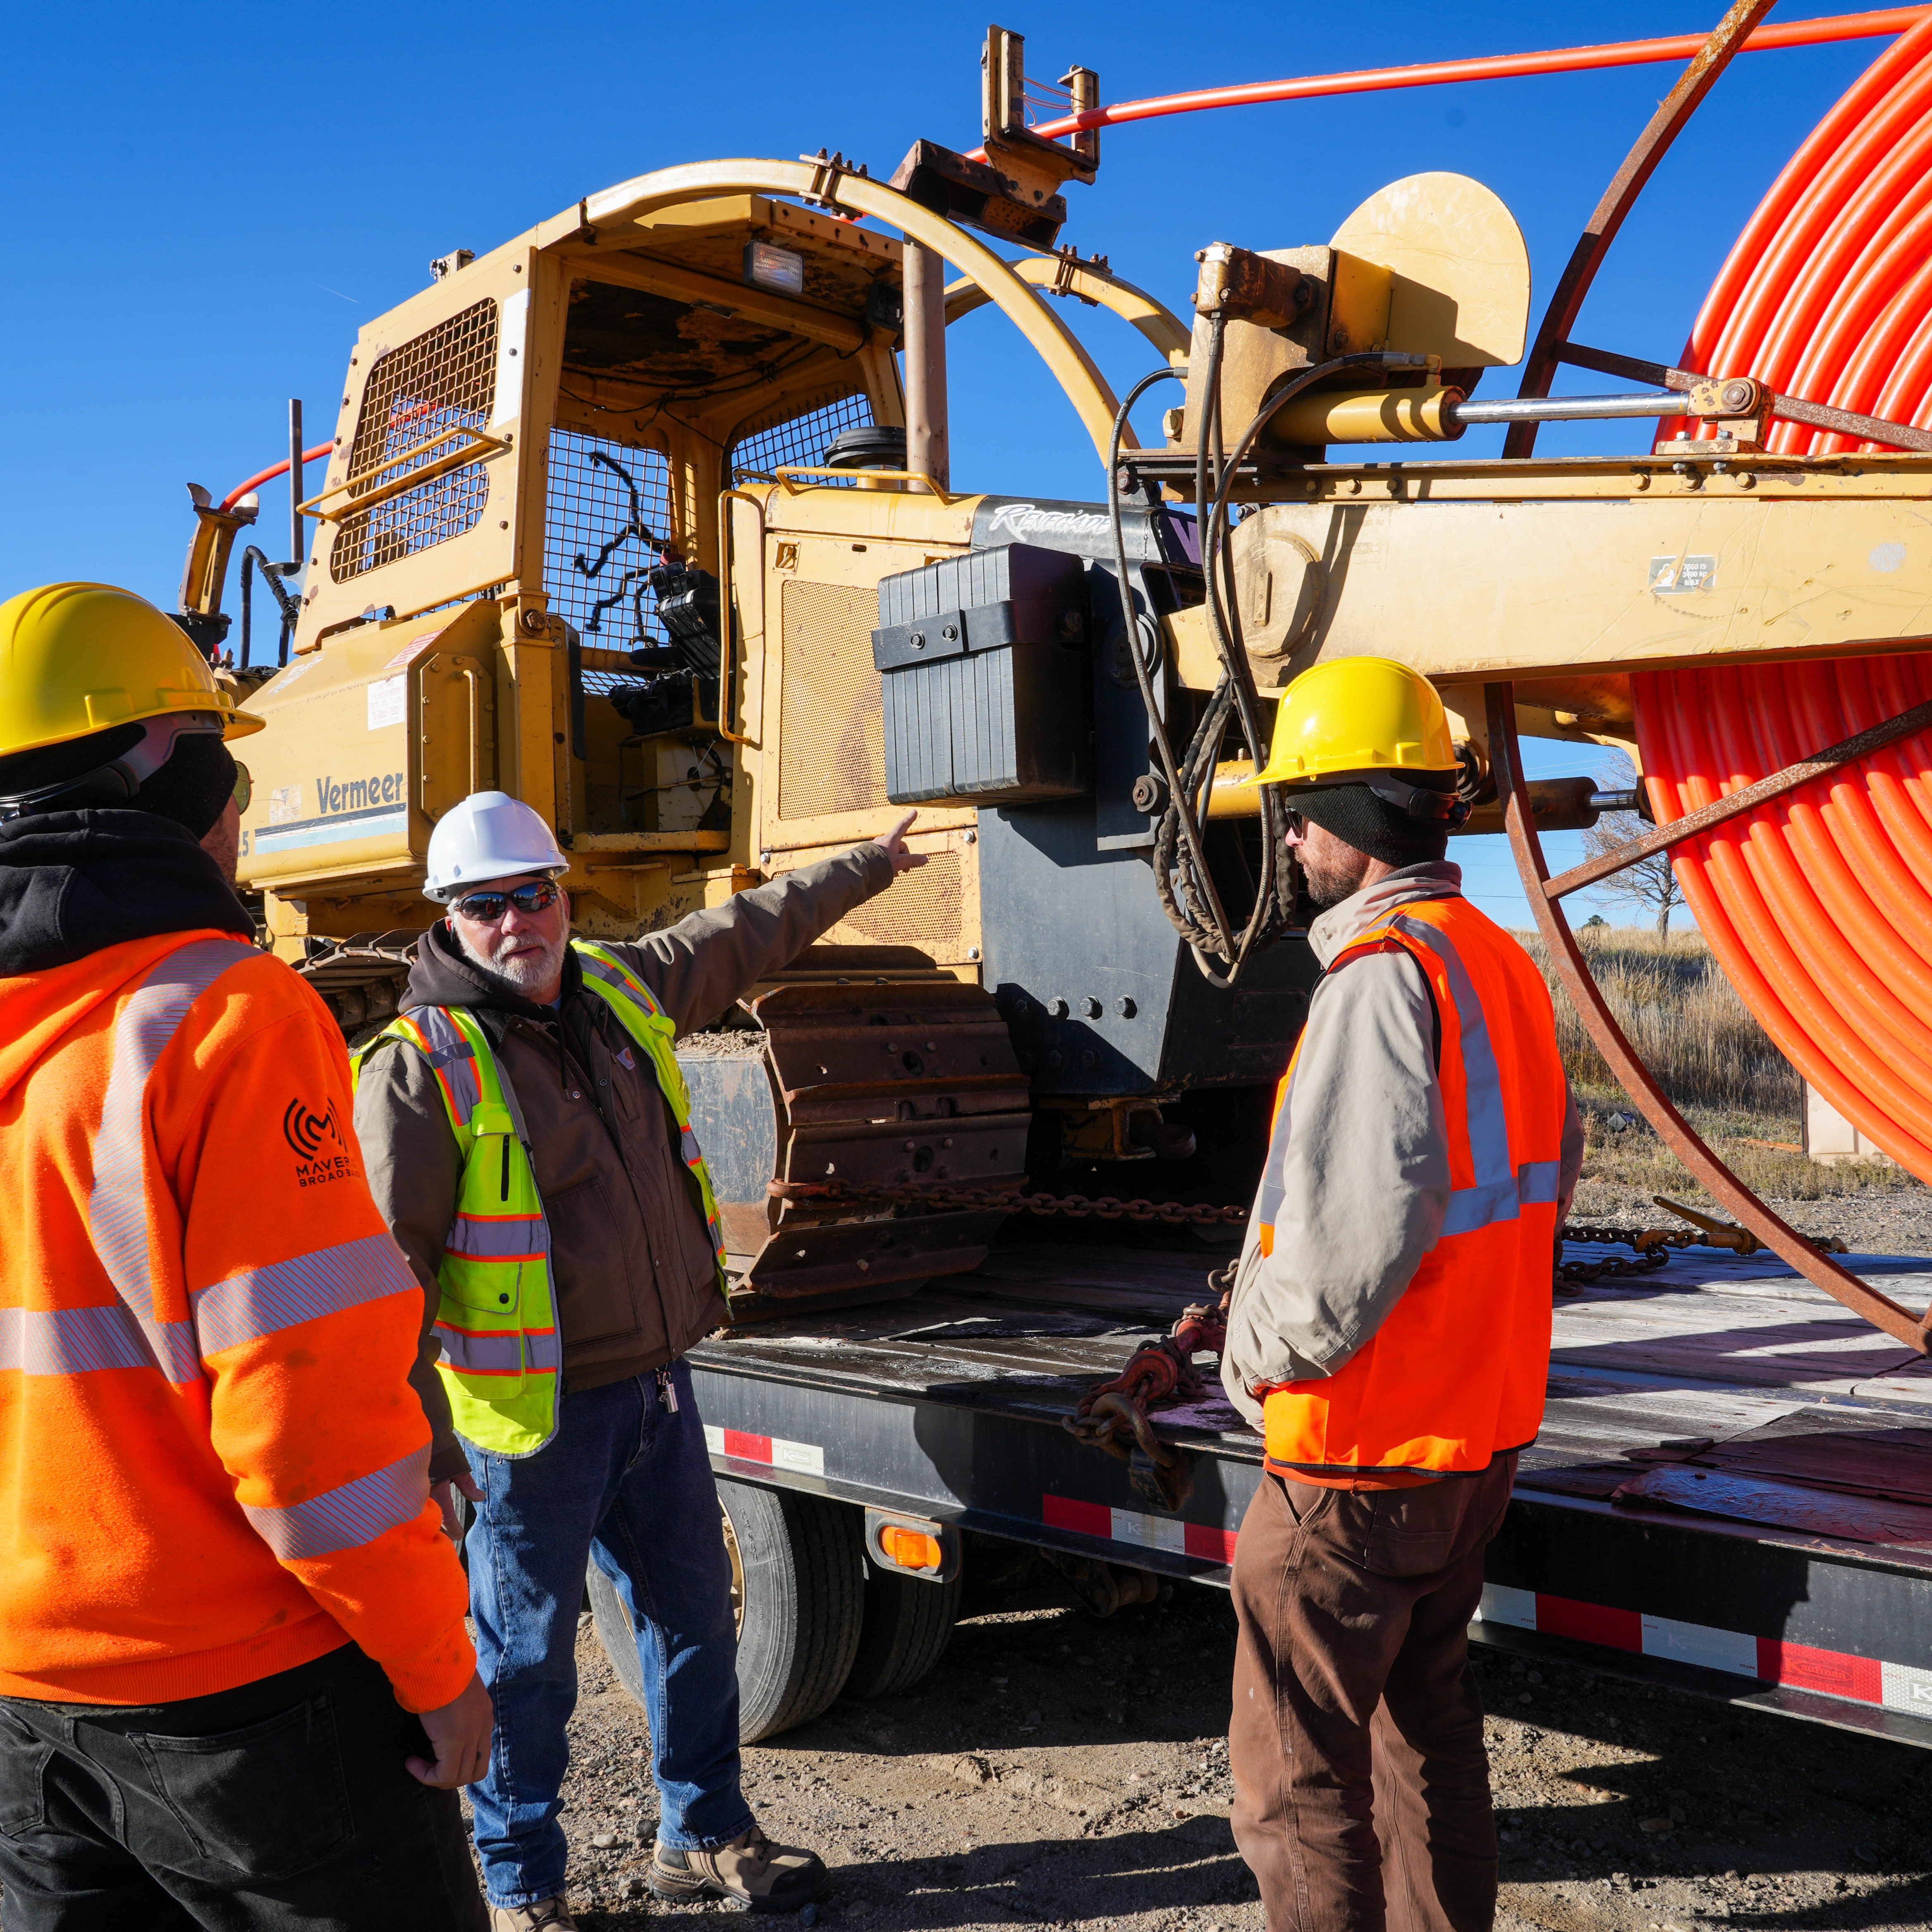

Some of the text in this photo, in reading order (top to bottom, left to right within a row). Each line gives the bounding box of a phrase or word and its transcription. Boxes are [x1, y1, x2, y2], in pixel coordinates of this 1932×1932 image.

[316, 772, 403, 814] Vermeer
[295, 1156, 351, 1178] MAVER
[1783, 1657, 1846, 1679] Kaufman
